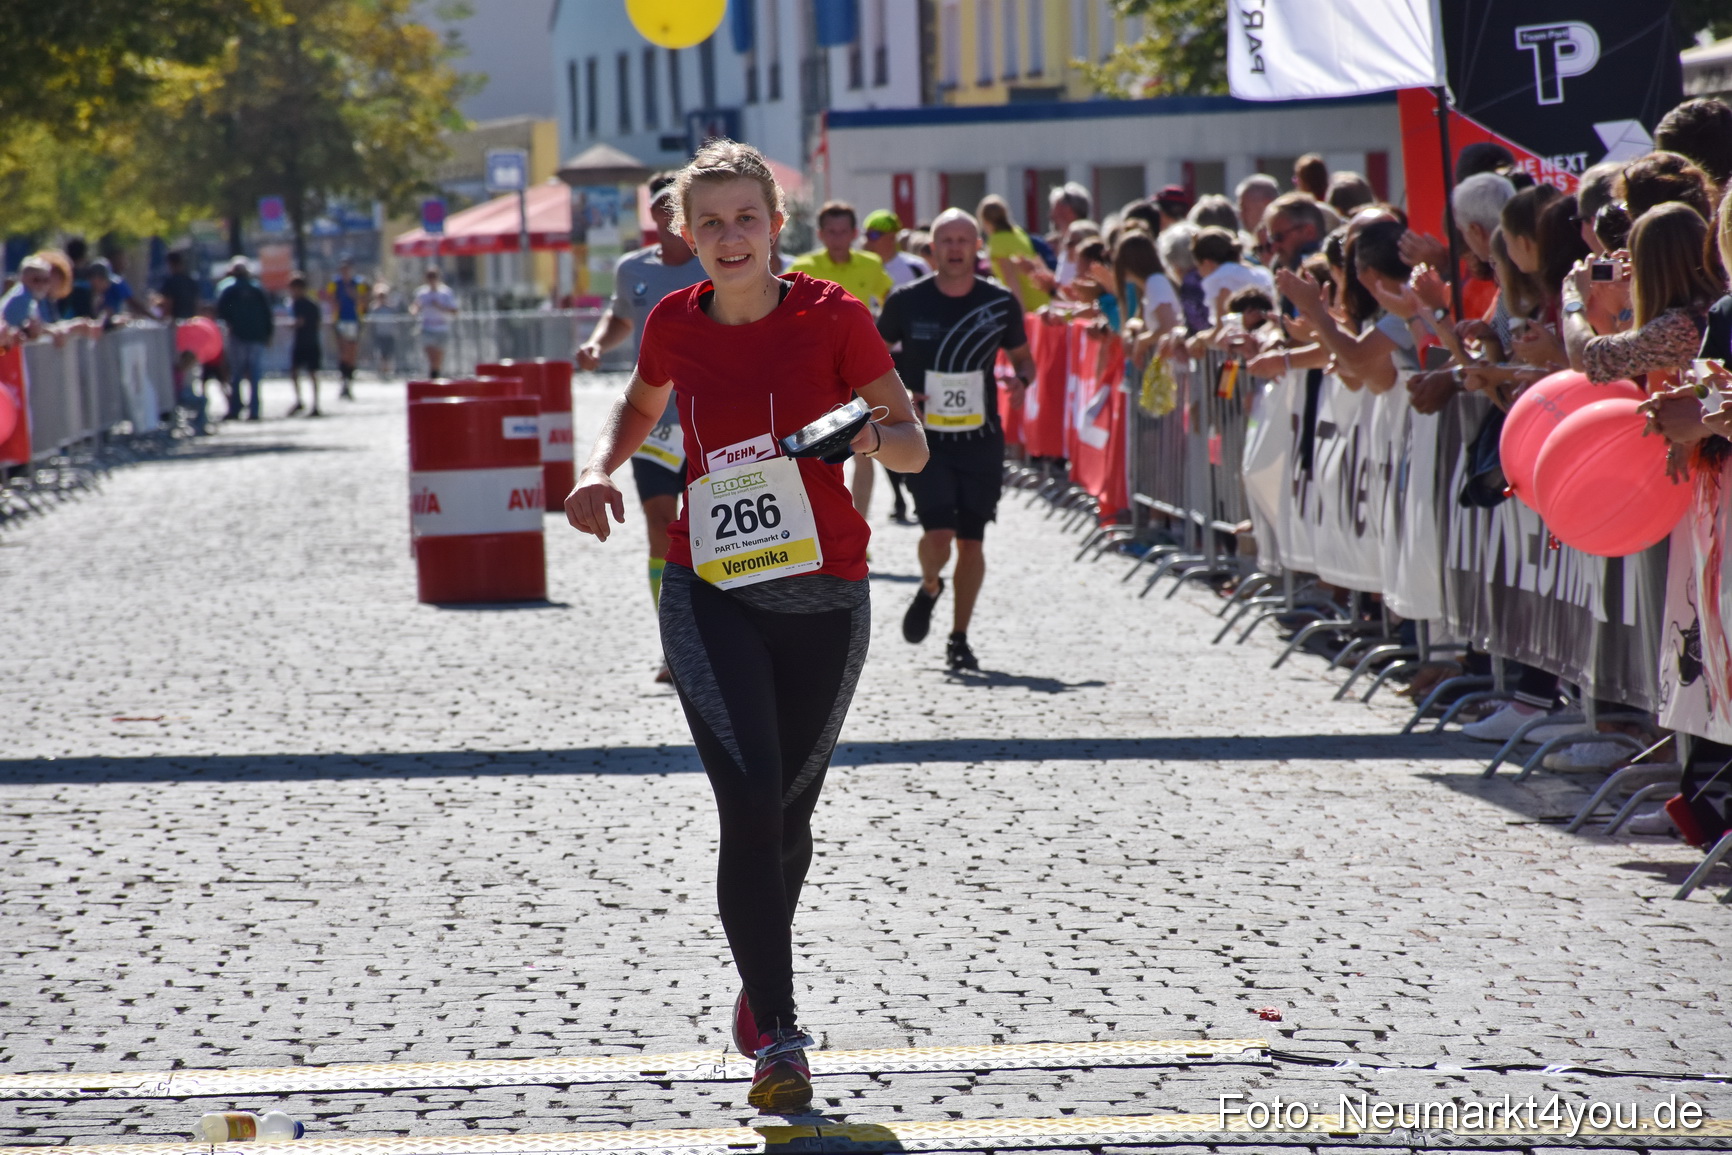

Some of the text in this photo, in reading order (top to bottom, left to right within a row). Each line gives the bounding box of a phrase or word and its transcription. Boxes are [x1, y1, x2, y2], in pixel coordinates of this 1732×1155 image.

[1541, 152, 1589, 174] NEXT
[944, 390, 966, 408] 26
[726, 445, 756, 464] DEHN
[711, 471, 767, 495] BOCK
[710, 493, 782, 541] 266
[714, 533, 779, 554] PARTL Neumarkt
[722, 550, 789, 575] Veronika
